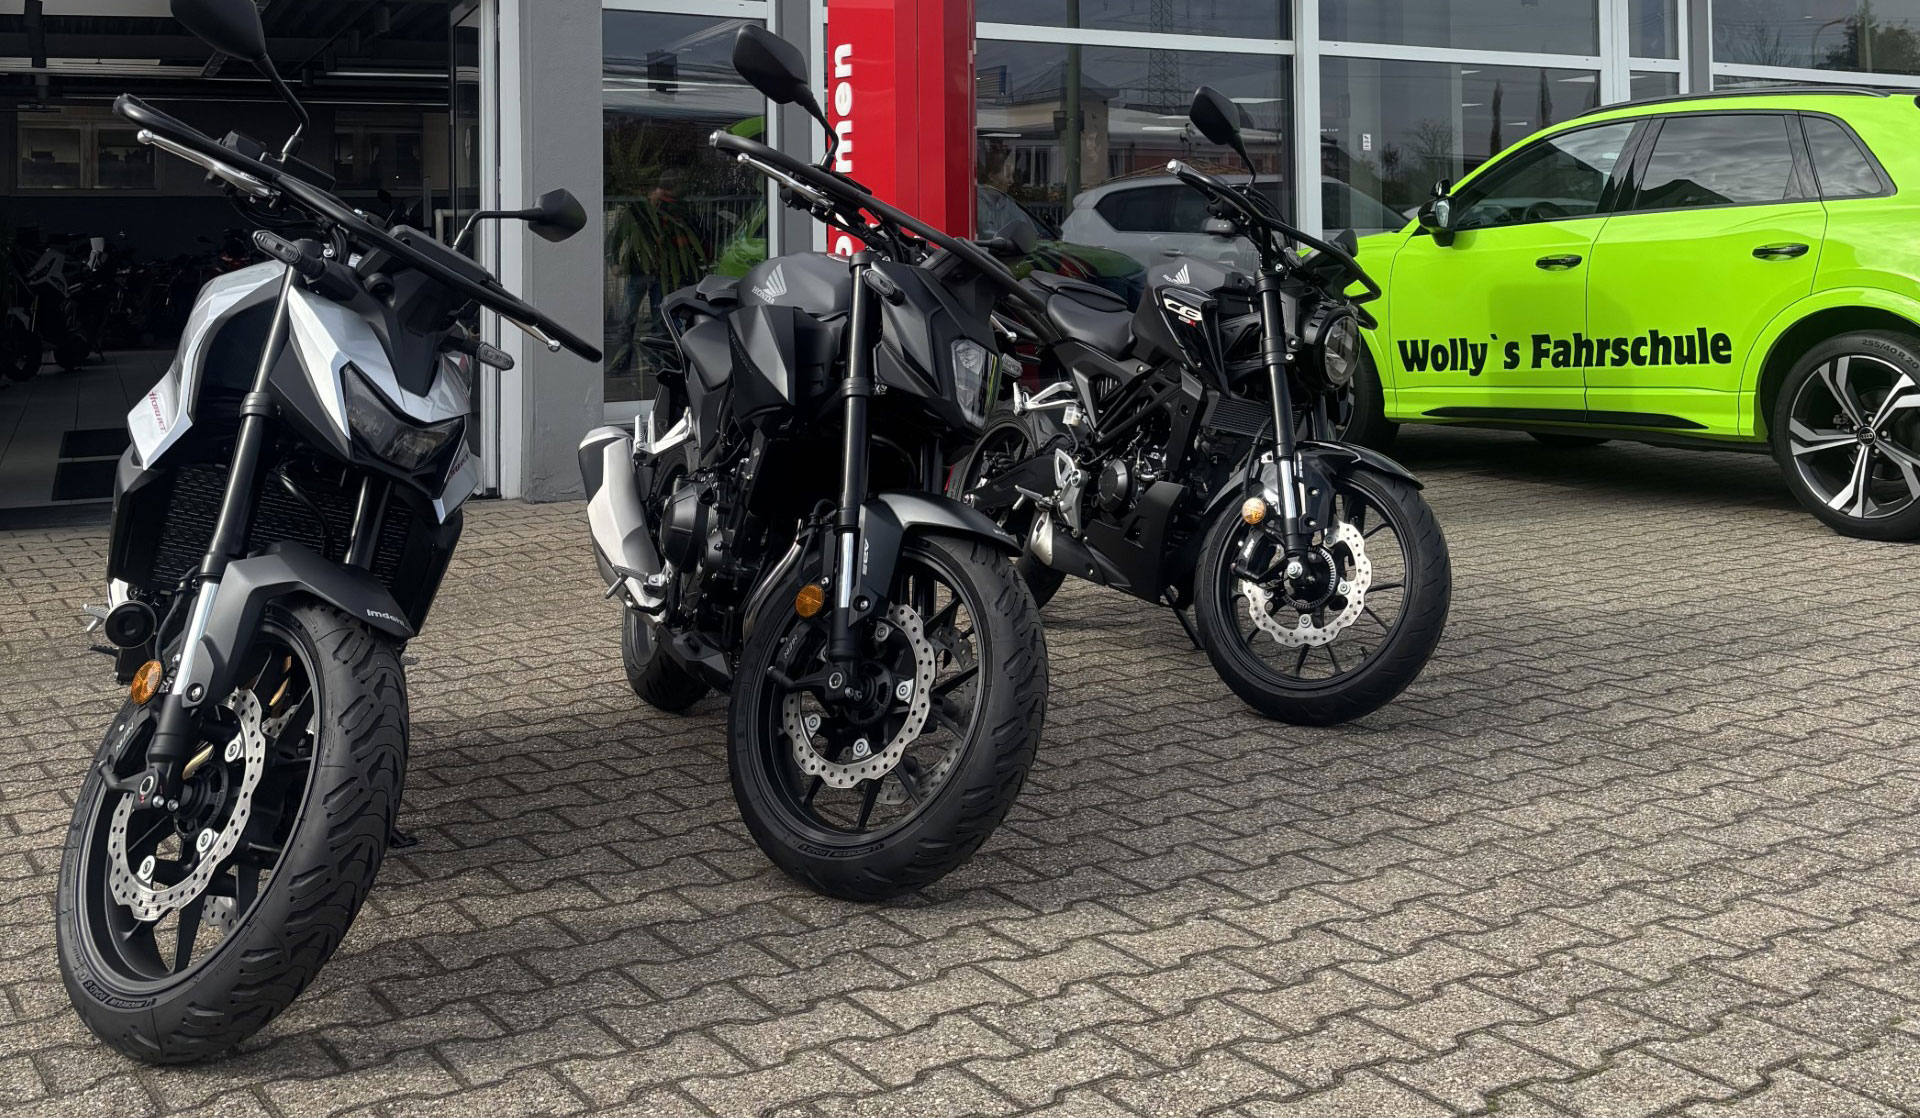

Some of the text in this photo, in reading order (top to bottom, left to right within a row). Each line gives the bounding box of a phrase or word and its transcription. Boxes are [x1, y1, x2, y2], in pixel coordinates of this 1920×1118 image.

[752, 285, 776, 305] HONDA
[1163, 298, 1203, 321] CB
[1531, 327, 1732, 369] Fahrschule
[1862, 339, 1898, 355] 255/40
[1906, 356, 1919, 369] 20
[90, 984, 108, 1000] ROAD
